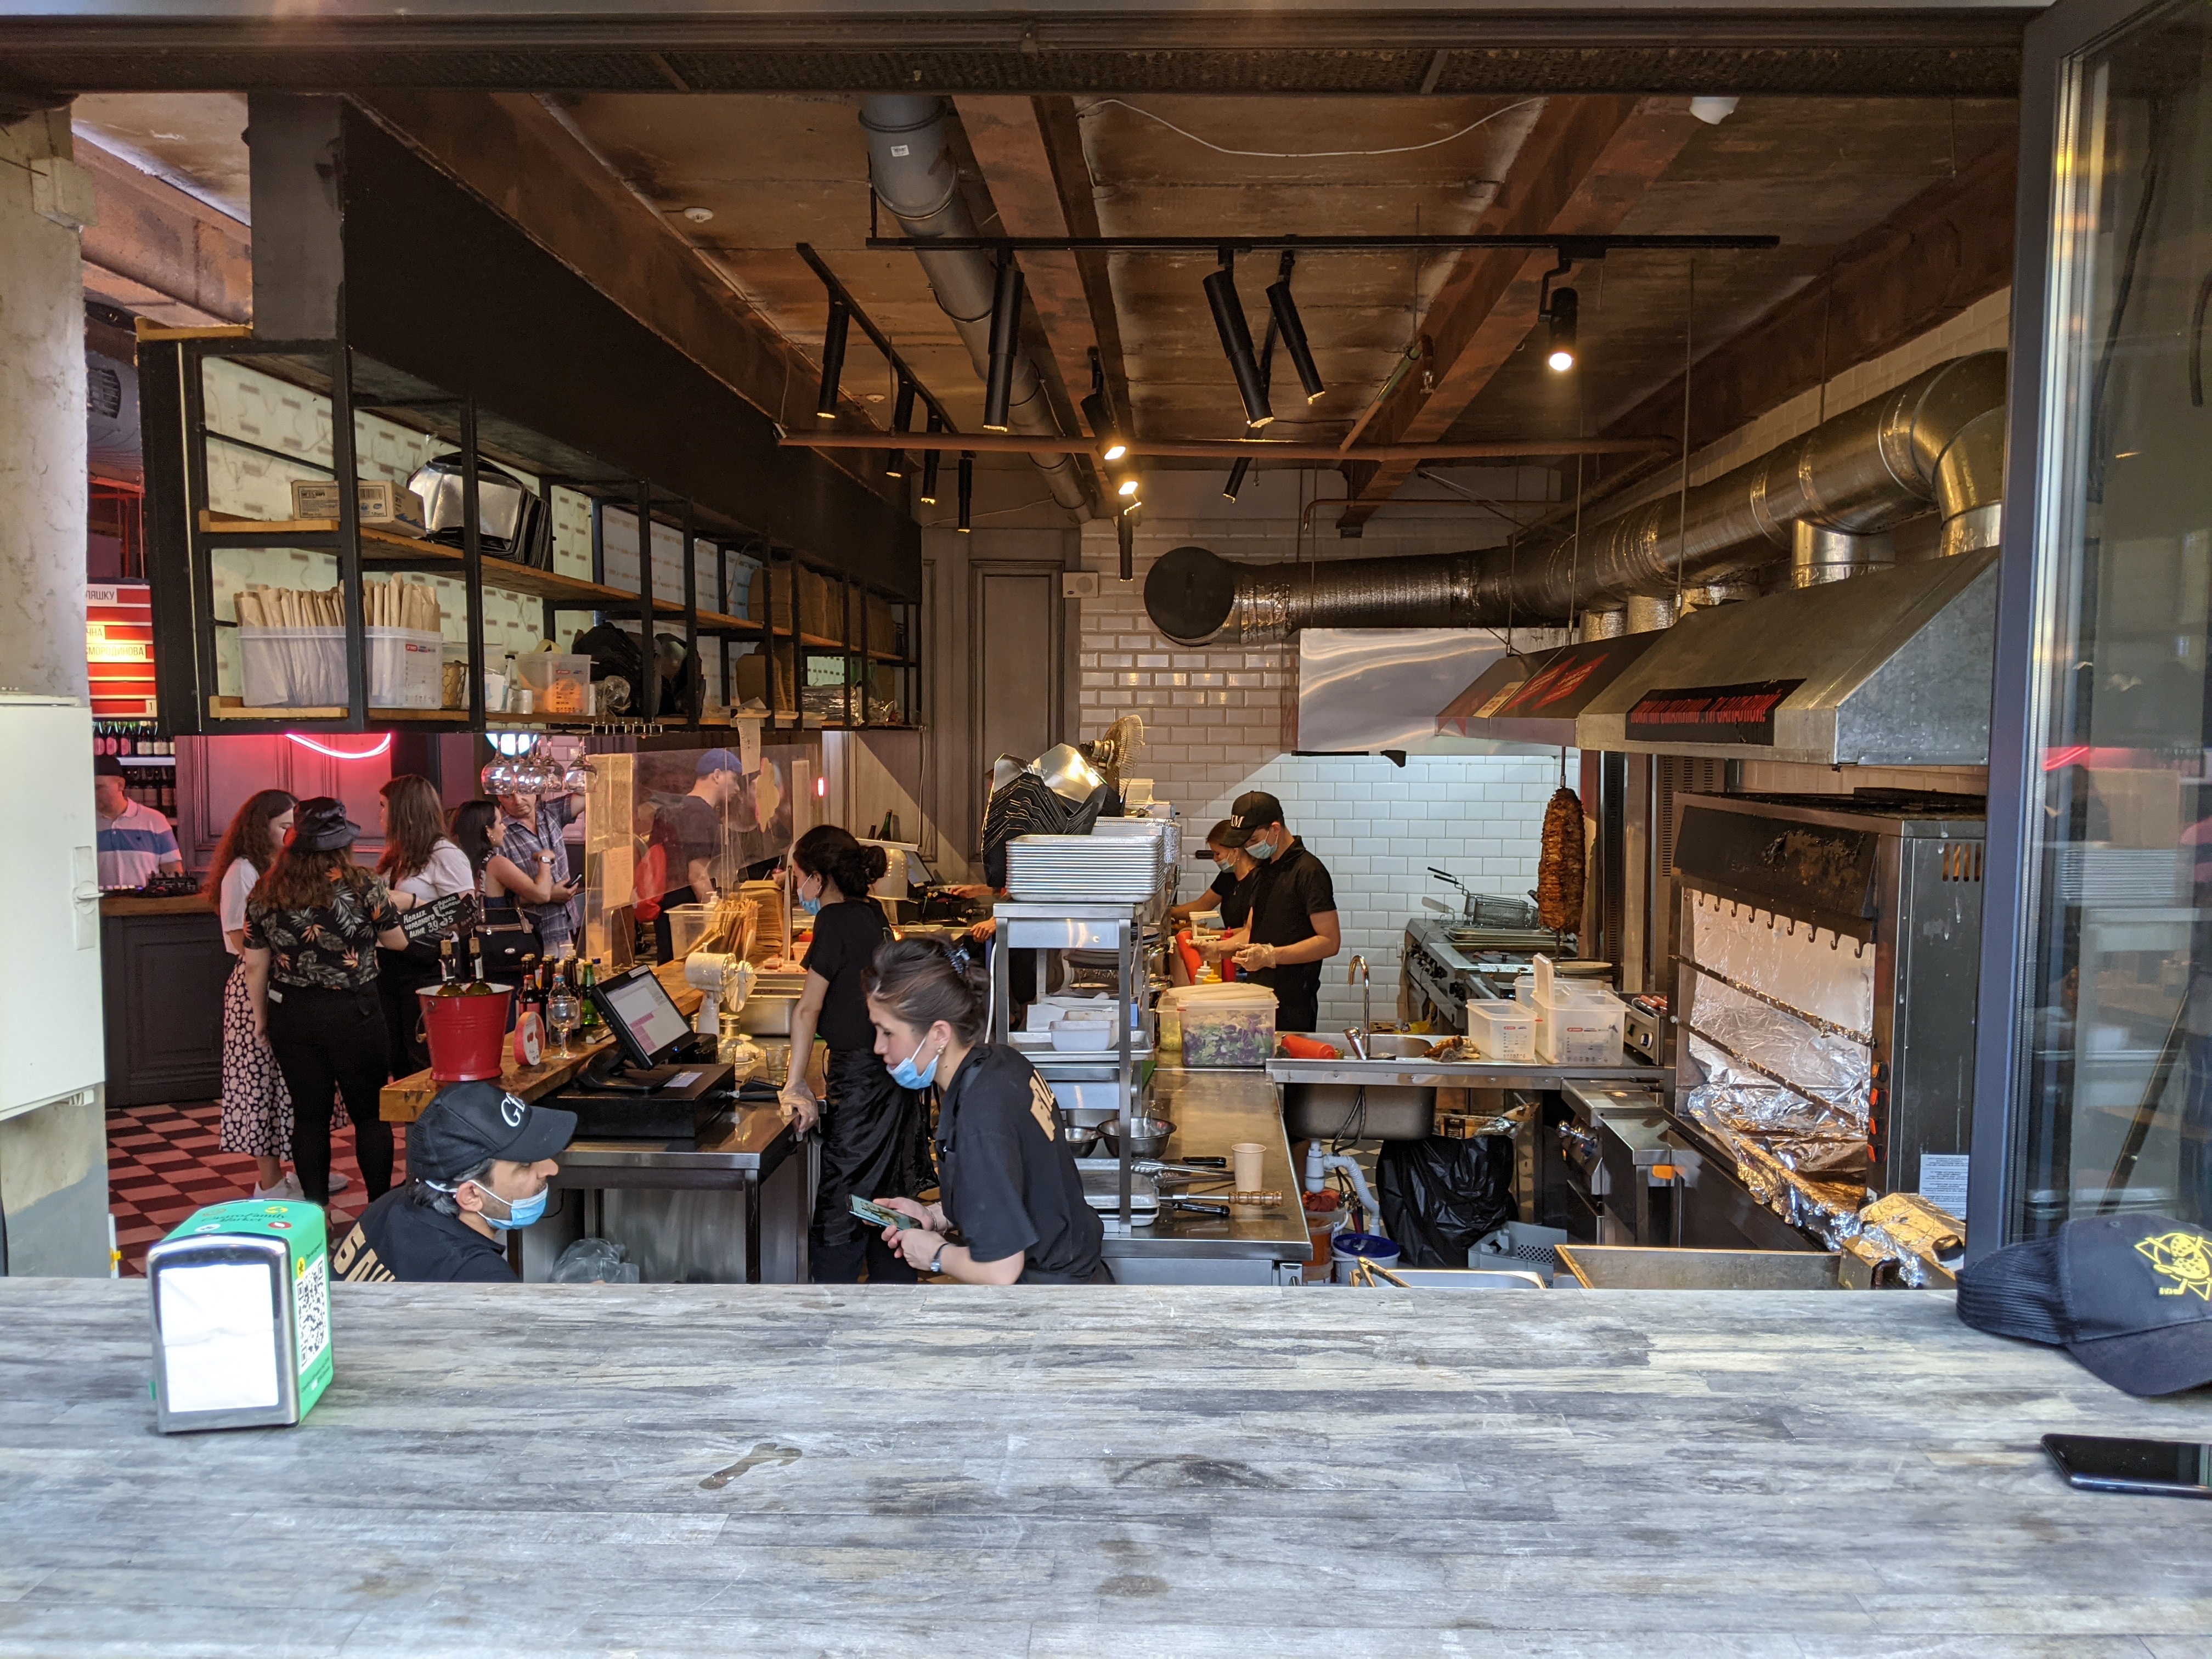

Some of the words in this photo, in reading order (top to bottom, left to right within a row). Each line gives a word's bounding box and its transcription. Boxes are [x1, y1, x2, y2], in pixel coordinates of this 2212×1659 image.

[86, 590, 115, 600] ЛЯШКУ
[86, 628, 103, 636] ЧНА
[86, 646, 144, 656] МОРОДИНОВА
[149, 702, 153, 710] 1
[427, 920, 438, 933] 39
